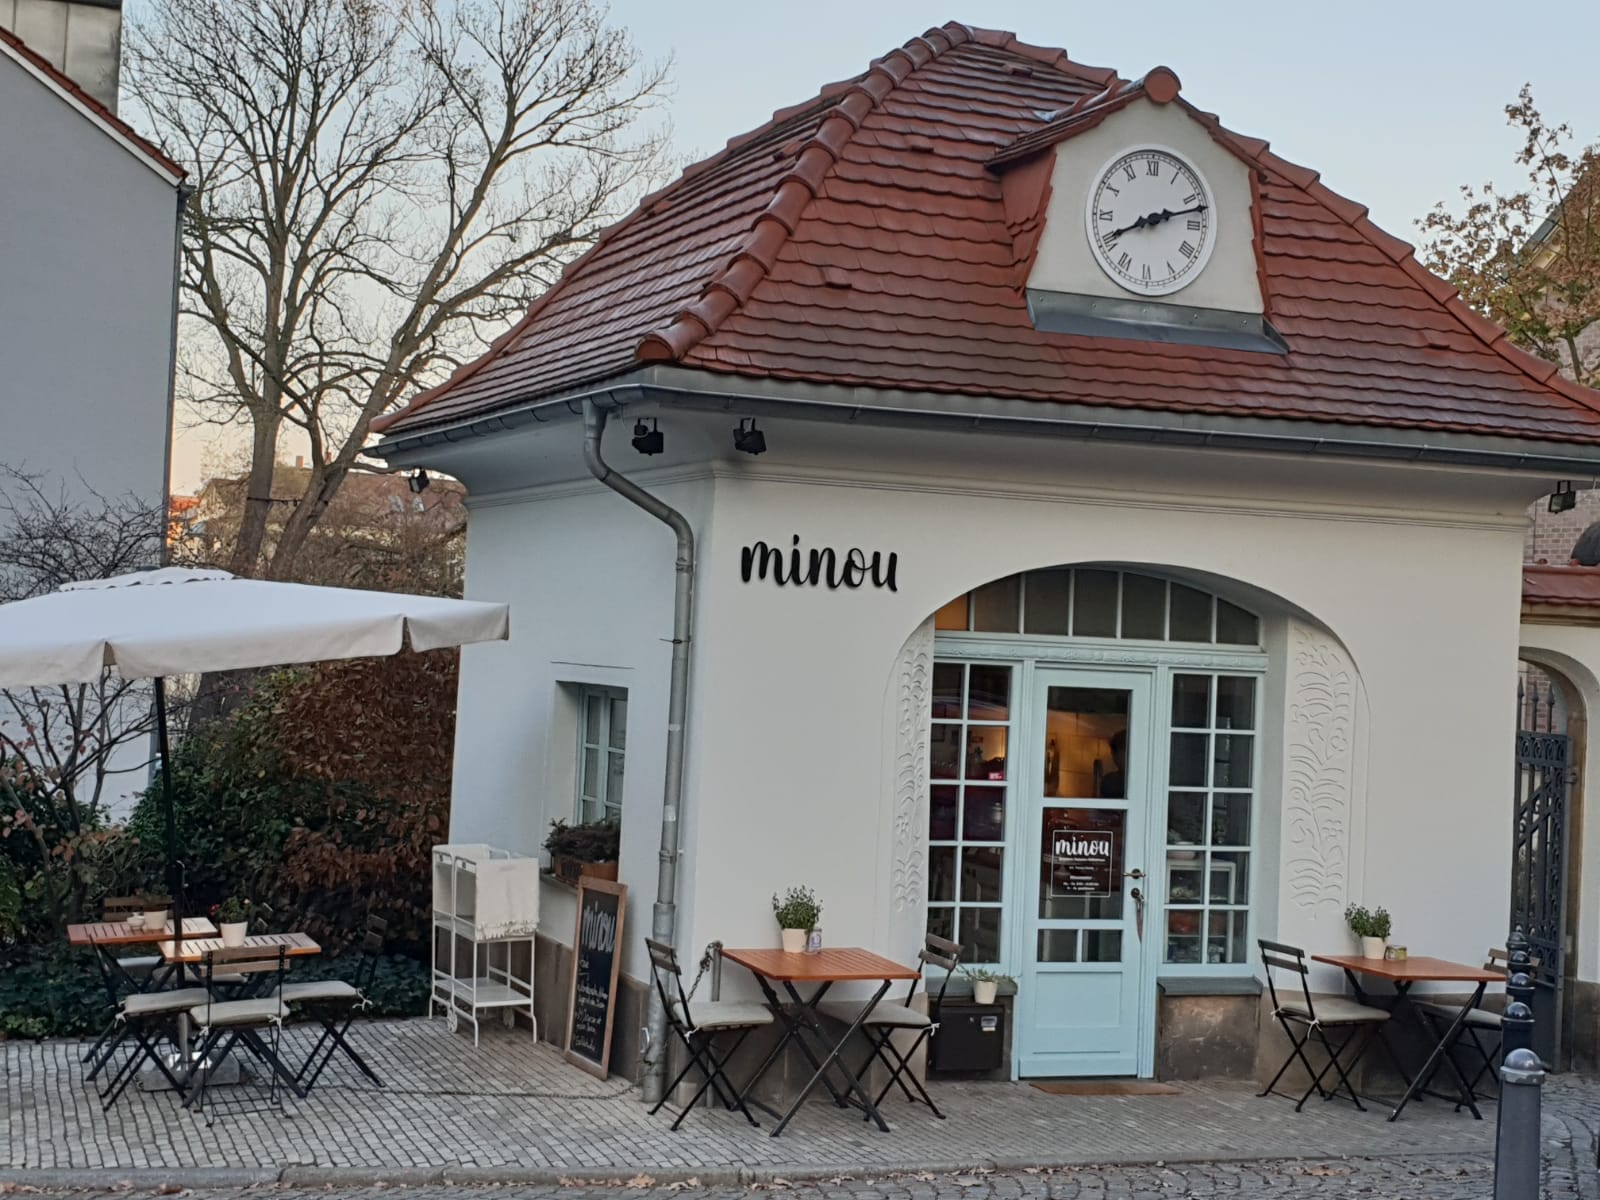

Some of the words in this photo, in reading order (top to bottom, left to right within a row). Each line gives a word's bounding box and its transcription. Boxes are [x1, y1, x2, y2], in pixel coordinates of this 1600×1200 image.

[1123, 164, 1136, 182] XI
[1145, 160, 1159, 176] XII
[1170, 171, 1180, 185] I
[1106, 183, 1120, 197] X
[1183, 193, 1196, 205] II
[1099, 209, 1113, 221] IX
[1187, 220, 1200, 231] III
[1118, 252, 1133, 272] VII
[1167, 260, 1176, 276] V
[1142, 263, 1152, 280] VI
[741, 534, 898, 592] minou
[1055, 836, 1109, 857] minou
